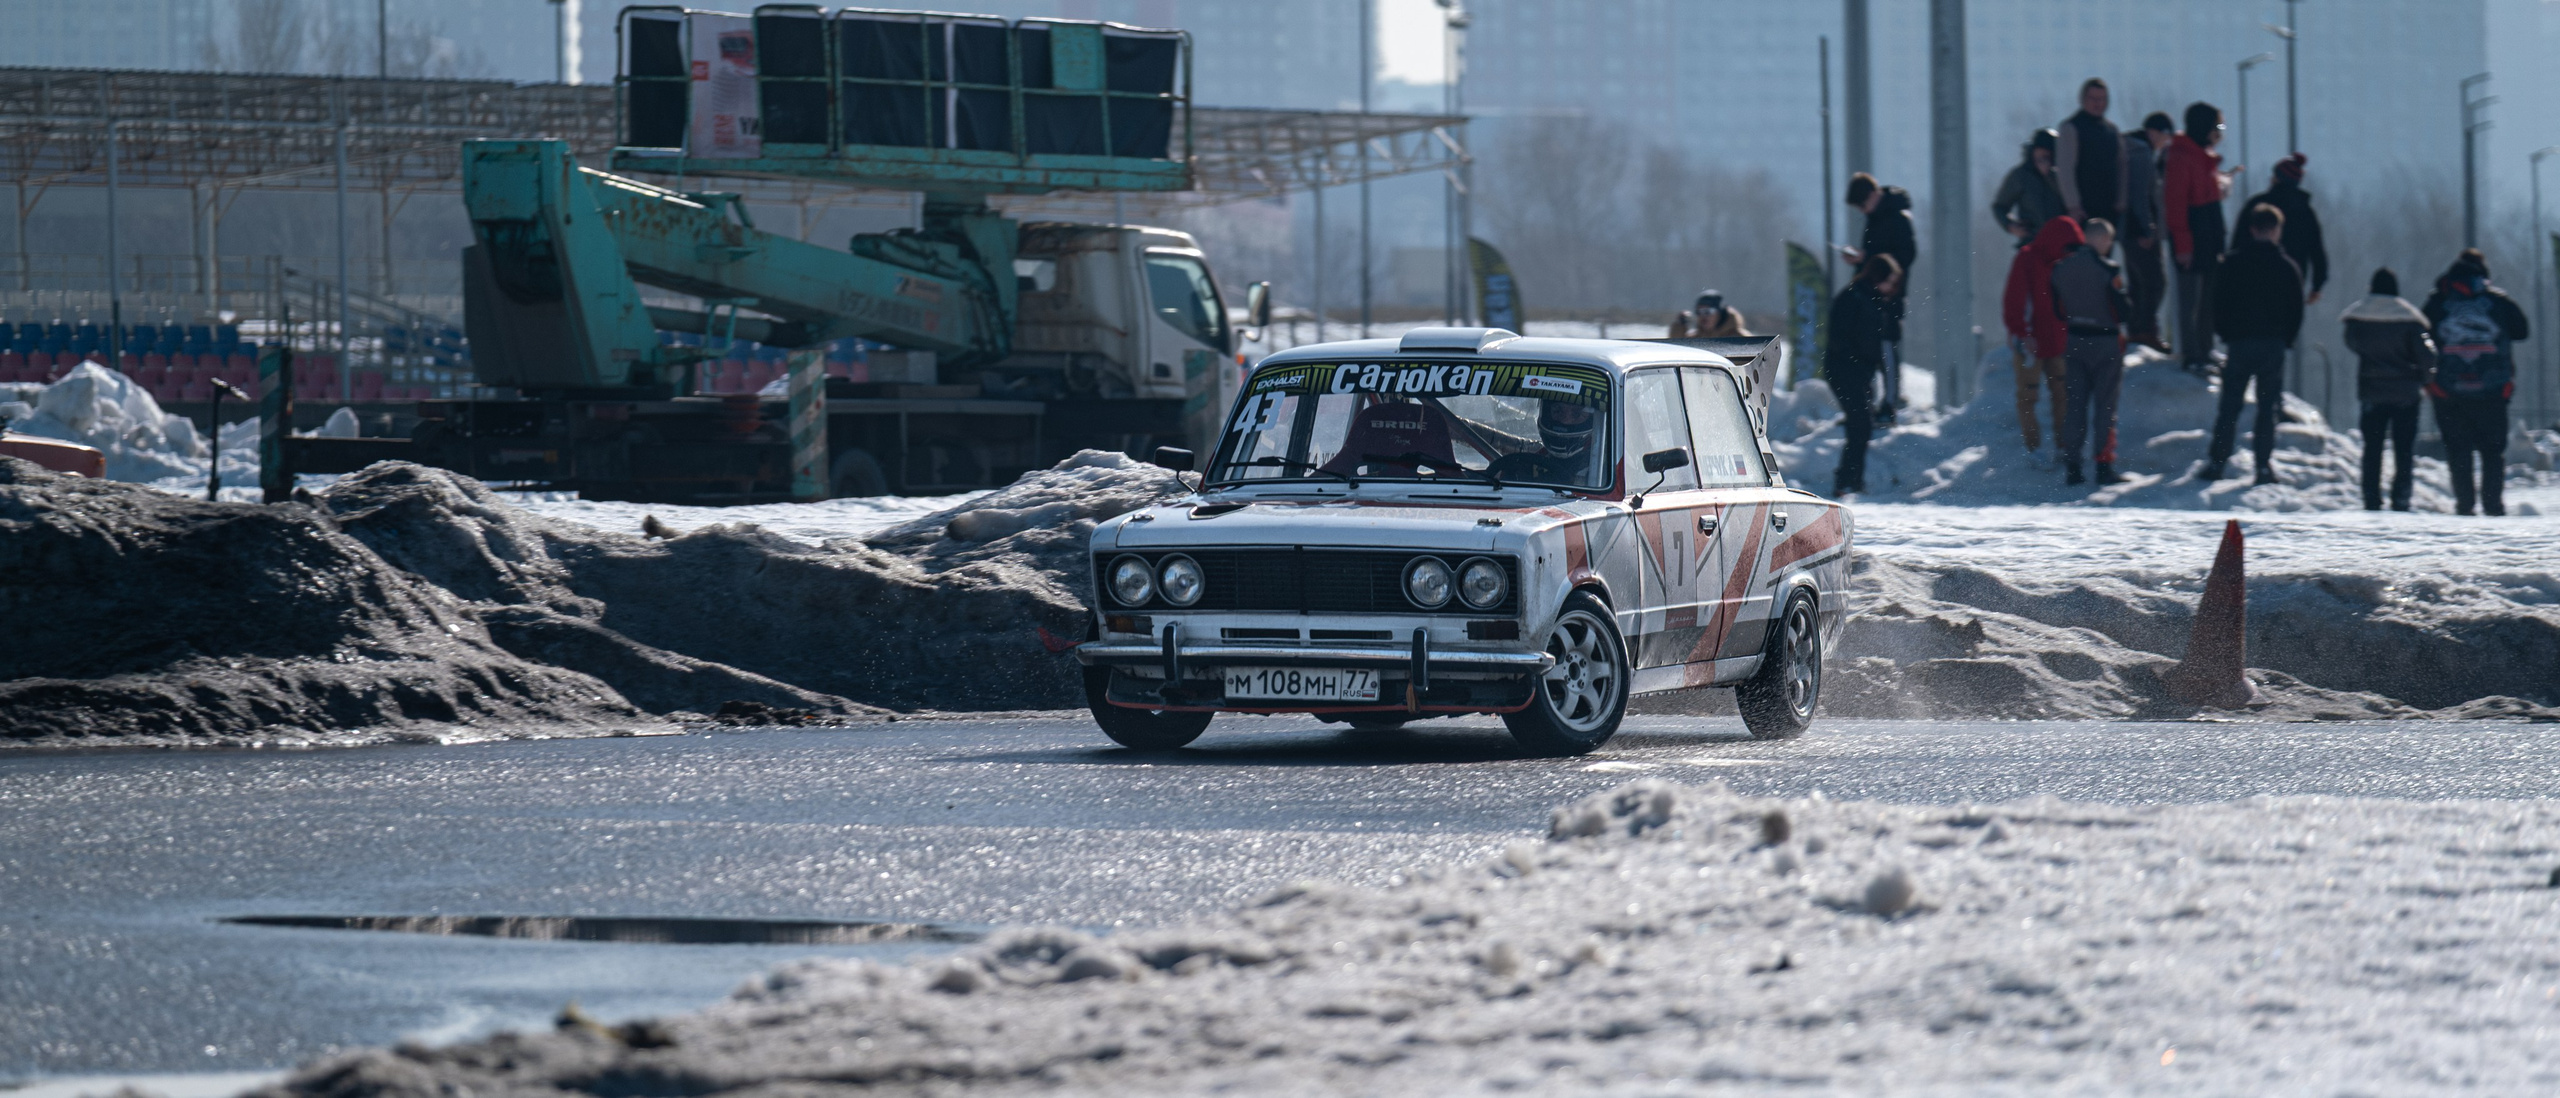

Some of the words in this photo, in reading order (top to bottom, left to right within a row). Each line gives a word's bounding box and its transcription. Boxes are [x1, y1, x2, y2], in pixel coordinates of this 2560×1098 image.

[1256, 375, 1305, 390] EXHAUST
[1540, 381, 1575, 390] TAKAYAMA
[1233, 391, 1286, 434] 43
[1371, 420, 1427, 430] BRIDE
[1673, 531, 1684, 586] 7
[1345, 670, 1370, 690] 77
[1343, 690, 1361, 698] RUS
